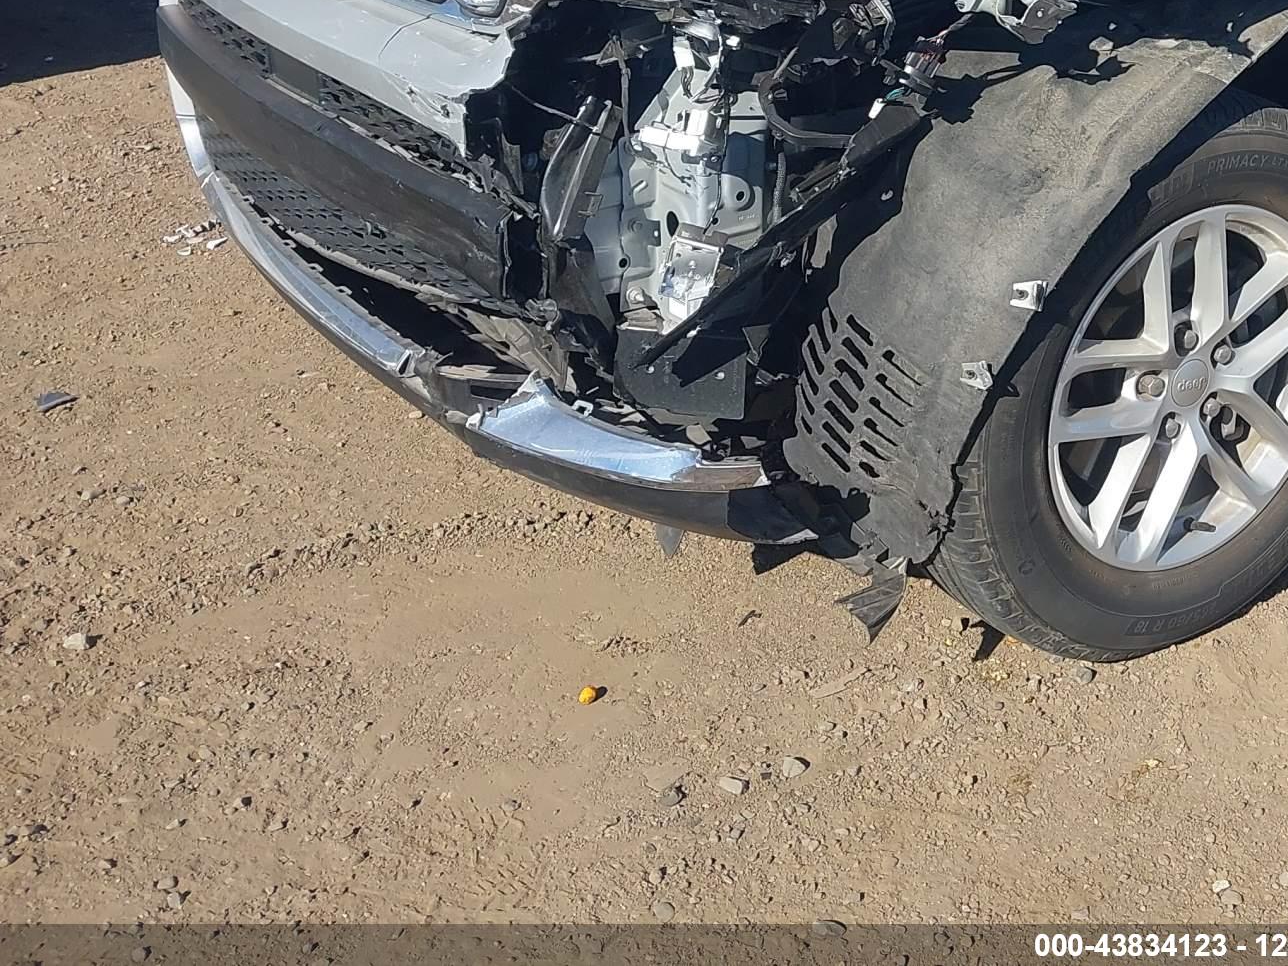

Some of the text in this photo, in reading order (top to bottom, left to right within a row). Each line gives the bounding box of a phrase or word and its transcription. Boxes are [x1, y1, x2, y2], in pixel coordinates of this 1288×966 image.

[1207, 154, 1266, 173] PRIMACY
[1177, 376, 1206, 392] Jeep
[1134, 619, 1149, 633] 18
